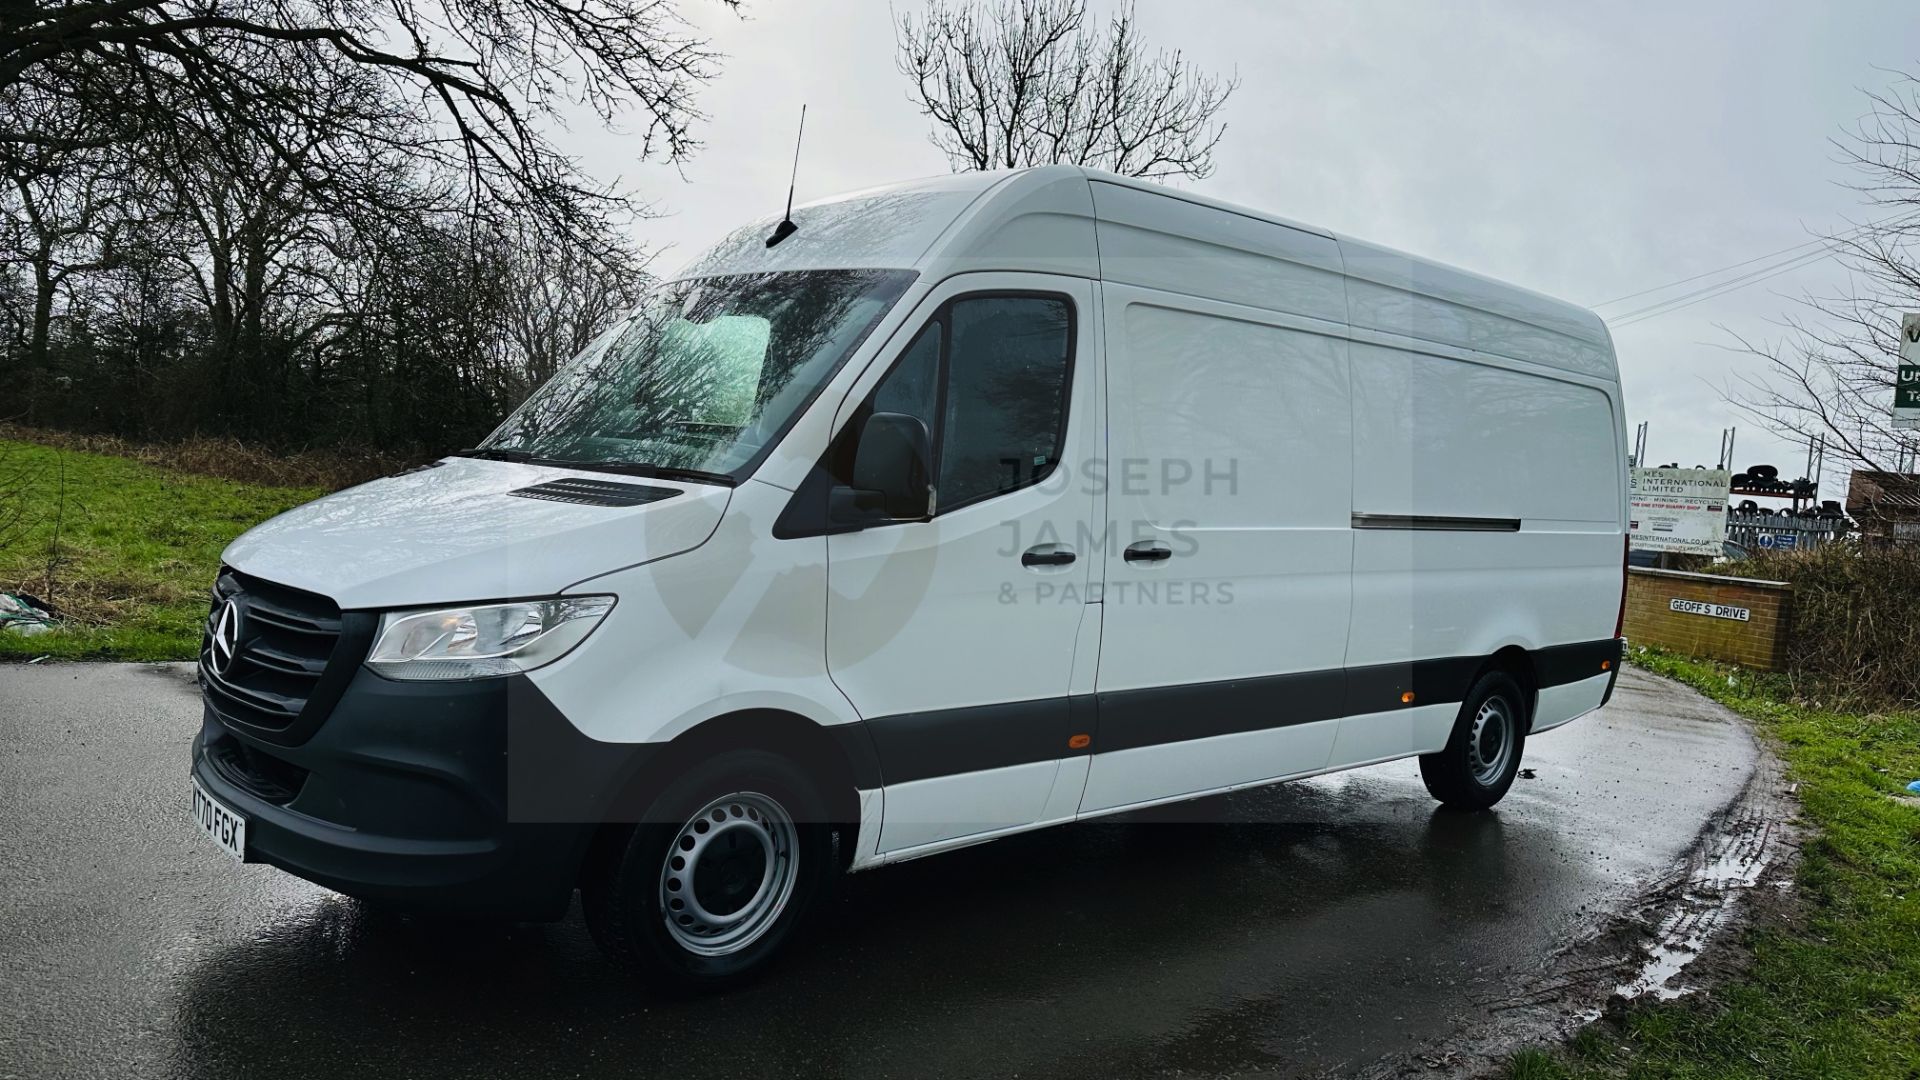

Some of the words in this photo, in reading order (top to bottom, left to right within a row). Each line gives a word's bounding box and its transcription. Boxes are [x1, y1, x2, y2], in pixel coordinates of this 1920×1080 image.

[1642, 479, 1727, 488] INTERNATIONAL
[1672, 600, 1702, 613] GEOFF
[1715, 606, 1747, 619] DRIVE
[213, 806, 238, 852] FGX
